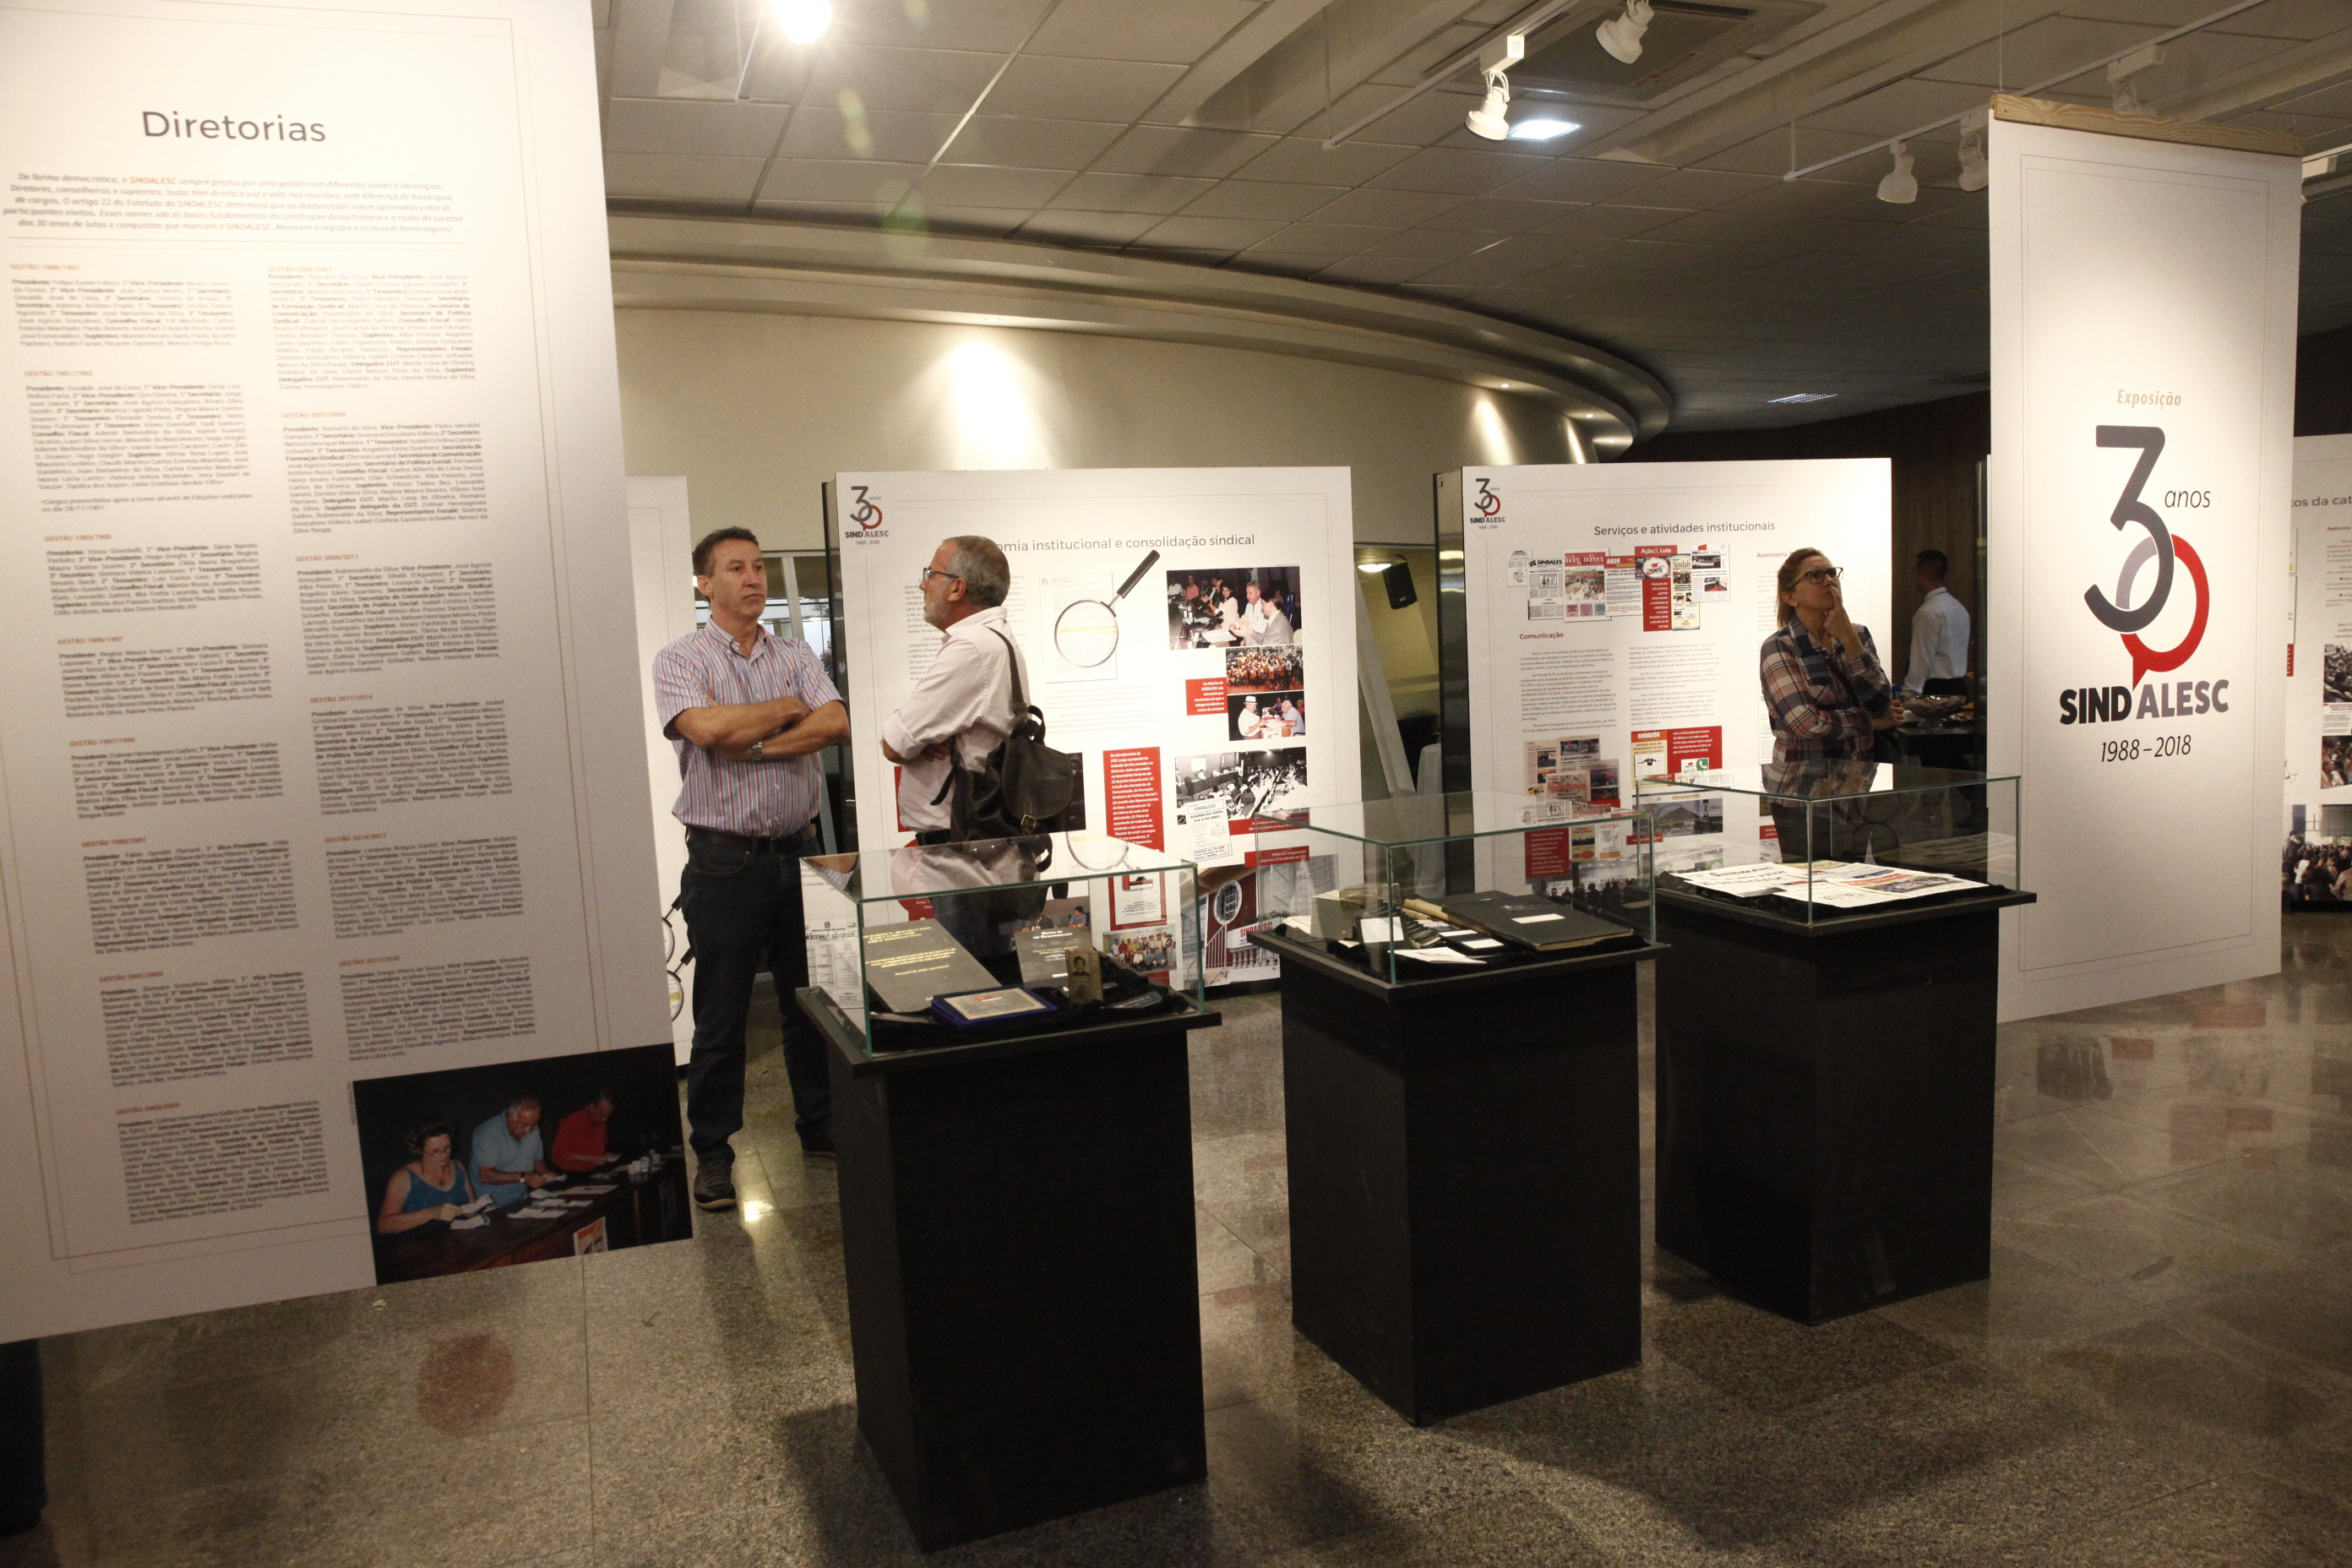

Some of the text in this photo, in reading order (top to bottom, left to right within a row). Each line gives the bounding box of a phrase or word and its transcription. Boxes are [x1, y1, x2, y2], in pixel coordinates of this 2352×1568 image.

[141, 110, 326, 143] Diretorias
[129, 177, 177, 185] SINDALESC
[362, 192, 399, 200] diferença
[2116, 389, 2181, 411] Exposição
[850, 486, 883, 531] 30
[1474, 478, 1500, 517] 30
[2164, 487, 2211, 509] anos
[1593, 523, 1775, 536] Serviços e atividades institucionais
[1032, 540, 1112, 551] institucional
[1115, 540, 1123, 548] e
[1125, 536, 1206, 548] consolidação
[1209, 534, 1255, 546] sindical
[2084, 425, 2210, 691] 30
[338, 694, 373, 702] 2011/2014
[2059, 678, 2230, 726] SINDALESC
